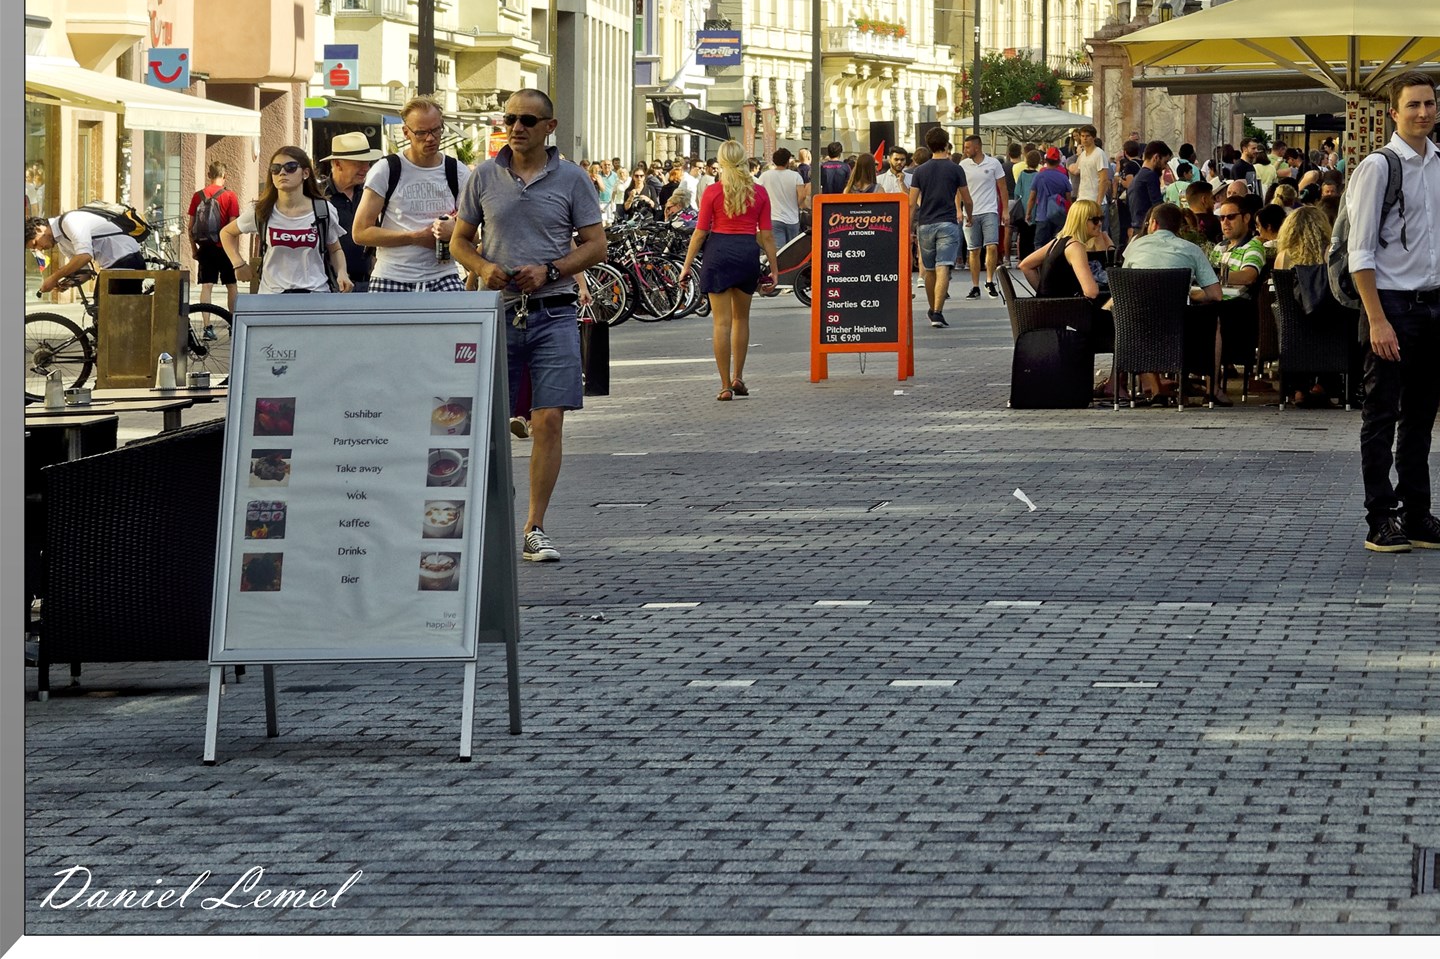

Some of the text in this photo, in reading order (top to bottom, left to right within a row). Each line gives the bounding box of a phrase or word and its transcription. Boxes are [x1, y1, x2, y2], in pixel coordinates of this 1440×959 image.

[1347, 102, 1359, 140] WEIN
[828, 213, 893, 229] Orangerie
[845, 250, 865, 258] €3.90
[828, 264, 839, 272] FR
[827, 275, 858, 283] Prosecco
[874, 274, 898, 282] €14.90
[827, 301, 857, 309] Shorties
[266, 349, 297, 358] SENSEI
[456, 346, 476, 361] illy
[344, 410, 382, 419] Sushibar
[333, 437, 389, 447] Partyservice
[336, 464, 383, 475] Take away
[347, 491, 367, 500] Wok
[339, 519, 370, 528] Kaffee
[338, 546, 367, 556] Drinks
[341, 575, 360, 584] Bier
[443, 611, 456, 619] live
